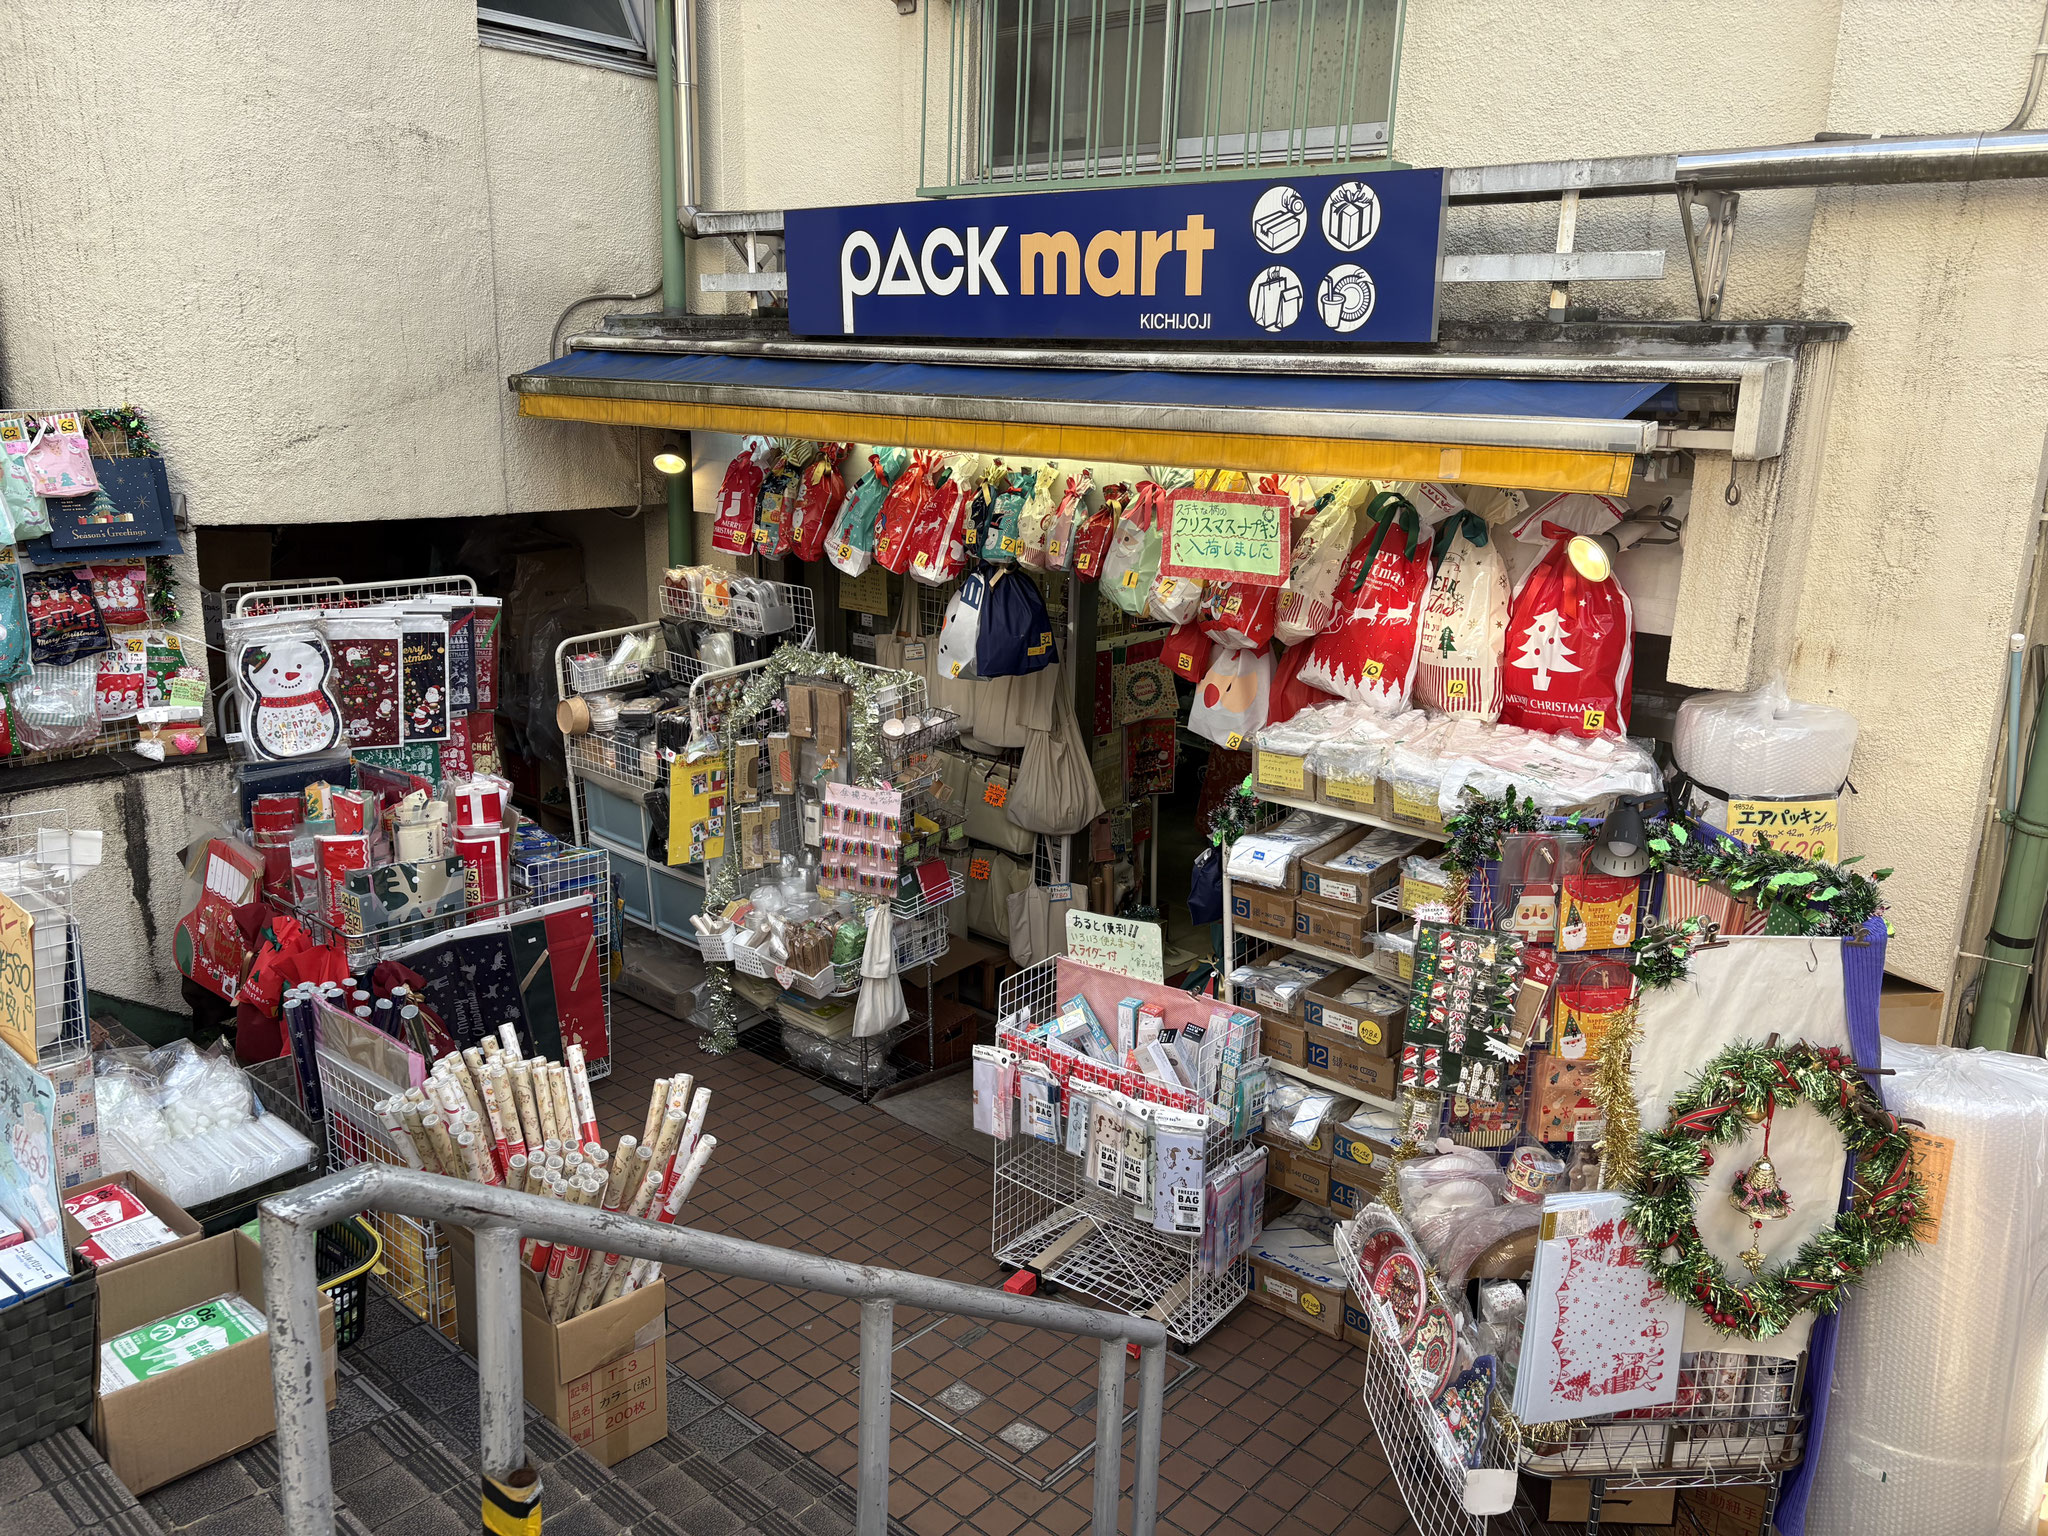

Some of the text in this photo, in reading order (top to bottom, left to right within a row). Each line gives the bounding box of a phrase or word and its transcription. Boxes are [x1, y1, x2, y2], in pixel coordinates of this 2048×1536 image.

[1020, 214, 1215, 296] mart
[1139, 313, 1212, 331] KICHIJOJI
[61, 421, 75, 432] 63
[3, 429, 17, 439] 62
[1176, 503, 1227, 516] ステキな柄の
[71, 527, 147, 540] Season's Greetings
[794, 528, 800, 540] 3
[1176, 517, 1279, 539] クリスマスナプキン
[733, 533, 744, 543] 38
[754, 531, 764, 541] 5
[968, 532, 974, 543] 6
[1004, 539, 1013, 550] 9
[1050, 542, 1057, 553] 2
[1185, 538, 1273, 560] 入荷しました
[840, 547, 849, 557] 8
[1375, 550, 1400, 567] rry
[1079, 555, 1087, 565] 4
[1162, 581, 1174, 594] 7
[37, 630, 99, 646] Merry Christmas
[167, 637, 177, 648] 68
[128, 640, 142, 652] 67
[403, 645, 425, 656] erry
[100, 652, 127, 661] MERR
[403, 653, 433, 664] stmas
[1363, 664, 1379, 677] 10
[1449, 682, 1464, 694] 12
[1530, 699, 1594, 713] CHRISTMAS
[1586, 713, 1602, 727] 15
[1226, 735, 1241, 748] 18
[1733, 803, 1754, 811] 48526
[1737, 807, 1828, 826] エアパッキン
[466, 870, 476, 881] 15
[1305, 873, 1317, 891] 6
[466, 889, 479, 901] 38
[1236, 900, 1247, 916] 5
[1296, 914, 1307, 931] 6
[1069, 943, 1117, 962] スライダー付
[1306, 1003, 1323, 1024] 12
[1309, 1045, 1327, 1066] 12
[1036, 1106, 1052, 1118] BAG
[1124, 1160, 1141, 1174] BAG
[1177, 1195, 1200, 1205] BAG
[195, 1306, 217, 1323] 50
[1346, 1311, 1368, 1330] 60
[152, 1326, 172, 1341] M
[608, 1359, 638, 1381] T-3
[570, 1382, 590, 1398] 記号
[571, 1400, 647, 1430] 品名 200枚
